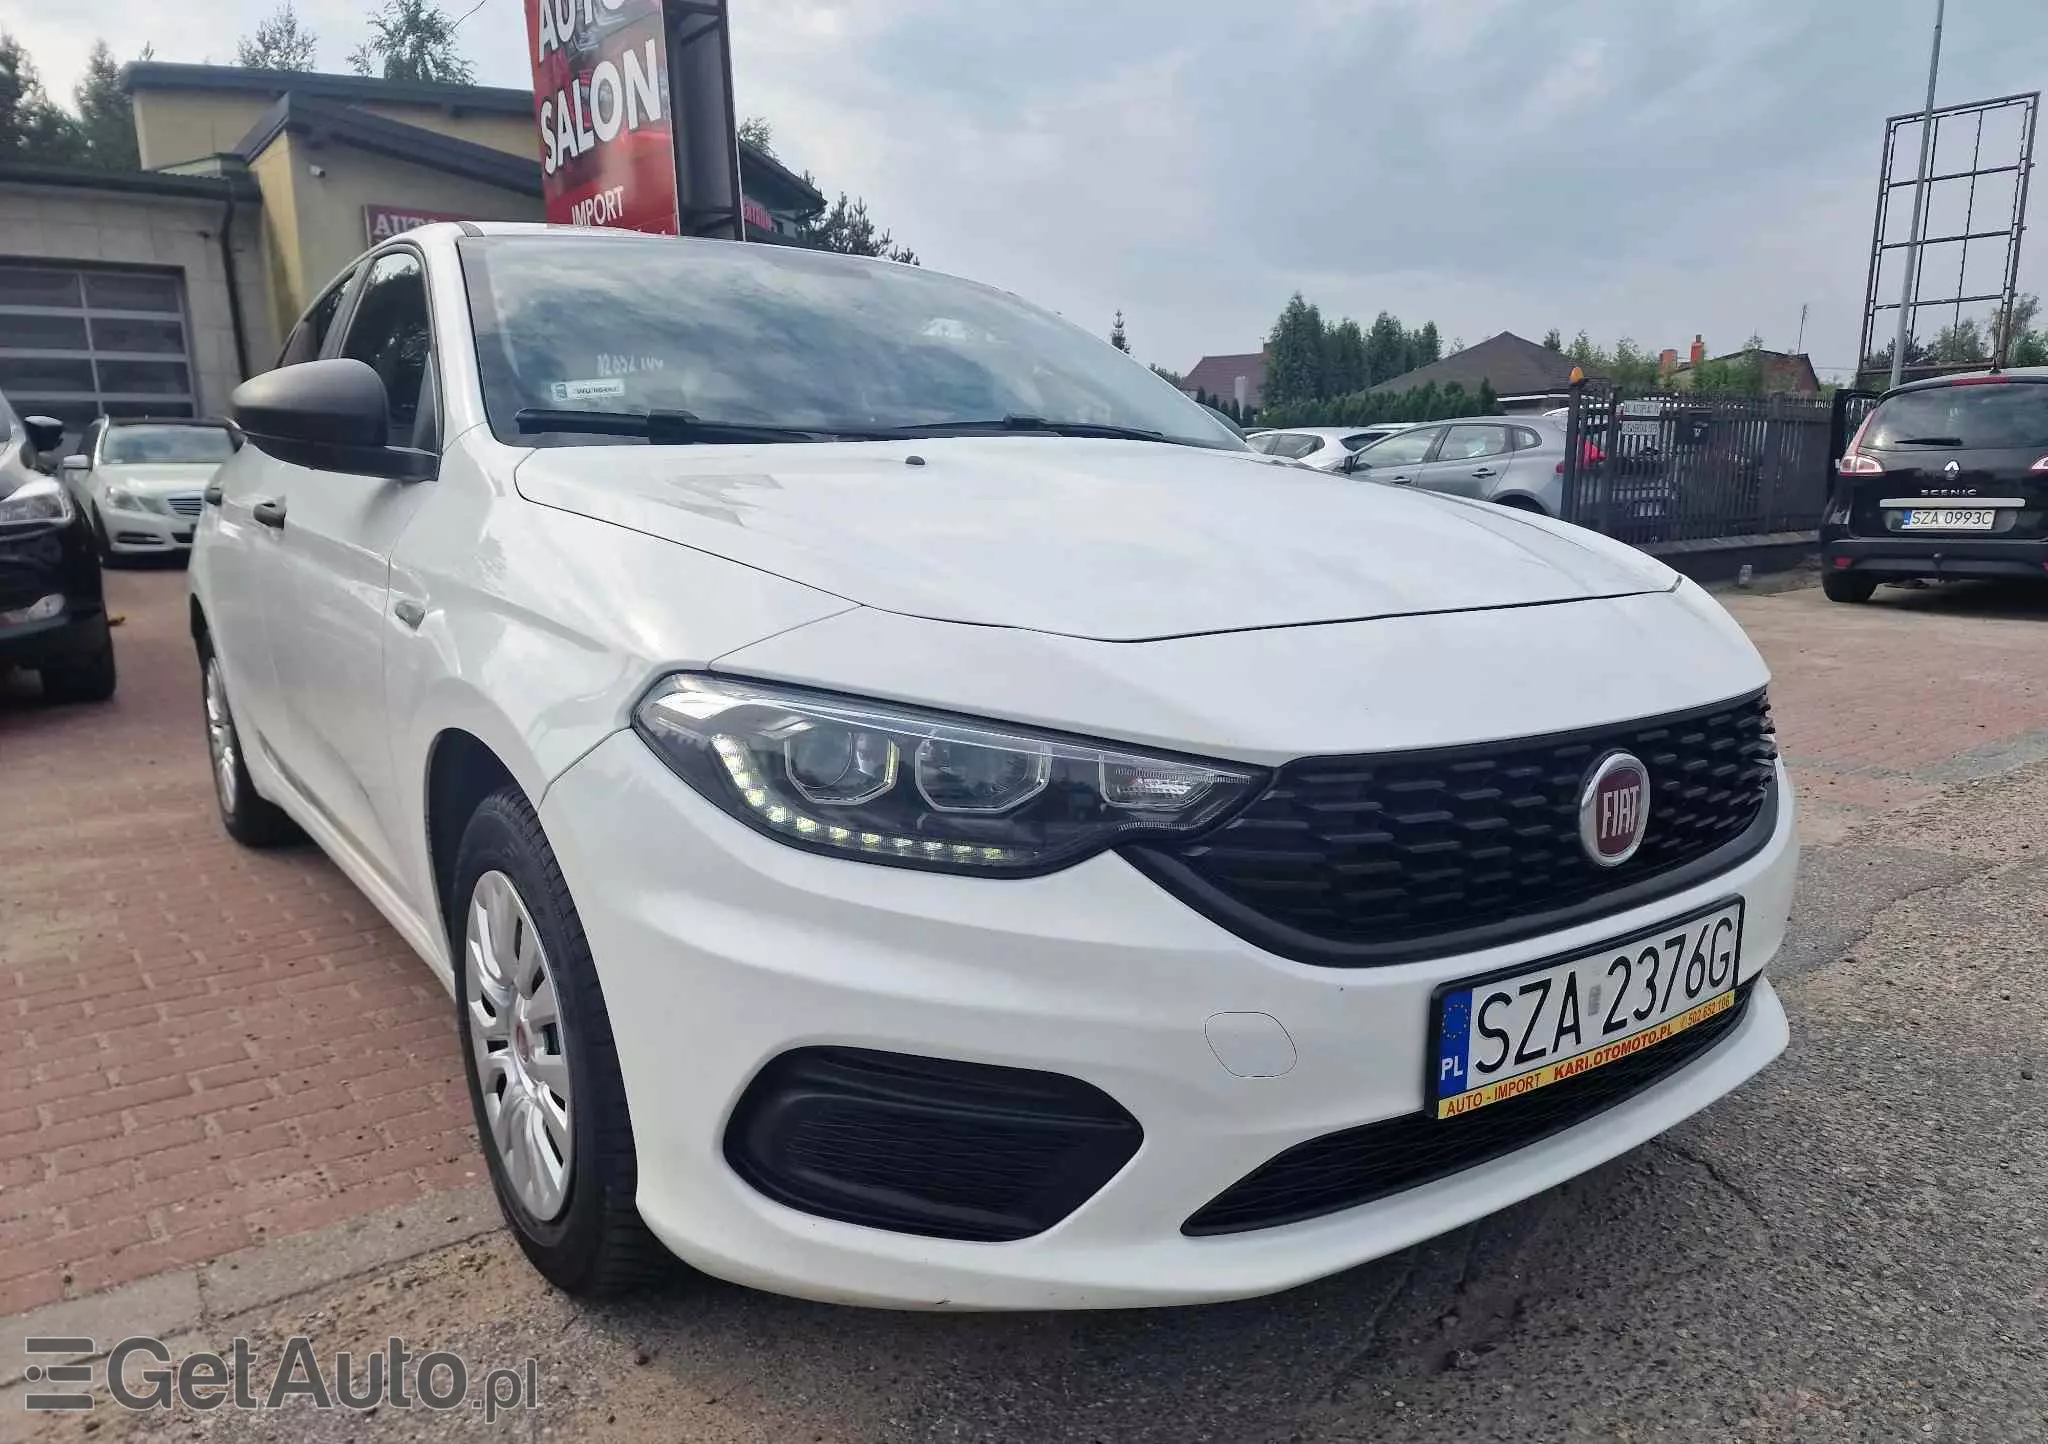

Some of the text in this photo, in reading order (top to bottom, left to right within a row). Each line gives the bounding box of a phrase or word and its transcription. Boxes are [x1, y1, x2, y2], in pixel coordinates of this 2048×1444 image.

[539, 0, 625, 63] AU
[540, 39, 662, 174] SALON
[571, 186, 625, 226] IMPORT
[1912, 511, 1993, 525] SZA 0993C
[1920, 488, 1977, 496] SCENIC
[1601, 785, 1640, 839] FIAT
[1475, 916, 1733, 1074] SZA 2376G
[1440, 1057, 1464, 1081] PL
[1446, 1092, 1483, 1117] AUTO
[1494, 1072, 1542, 1101] IMPORT
[1553, 1023, 1673, 1080] KARI.OTOMOTO.PL
